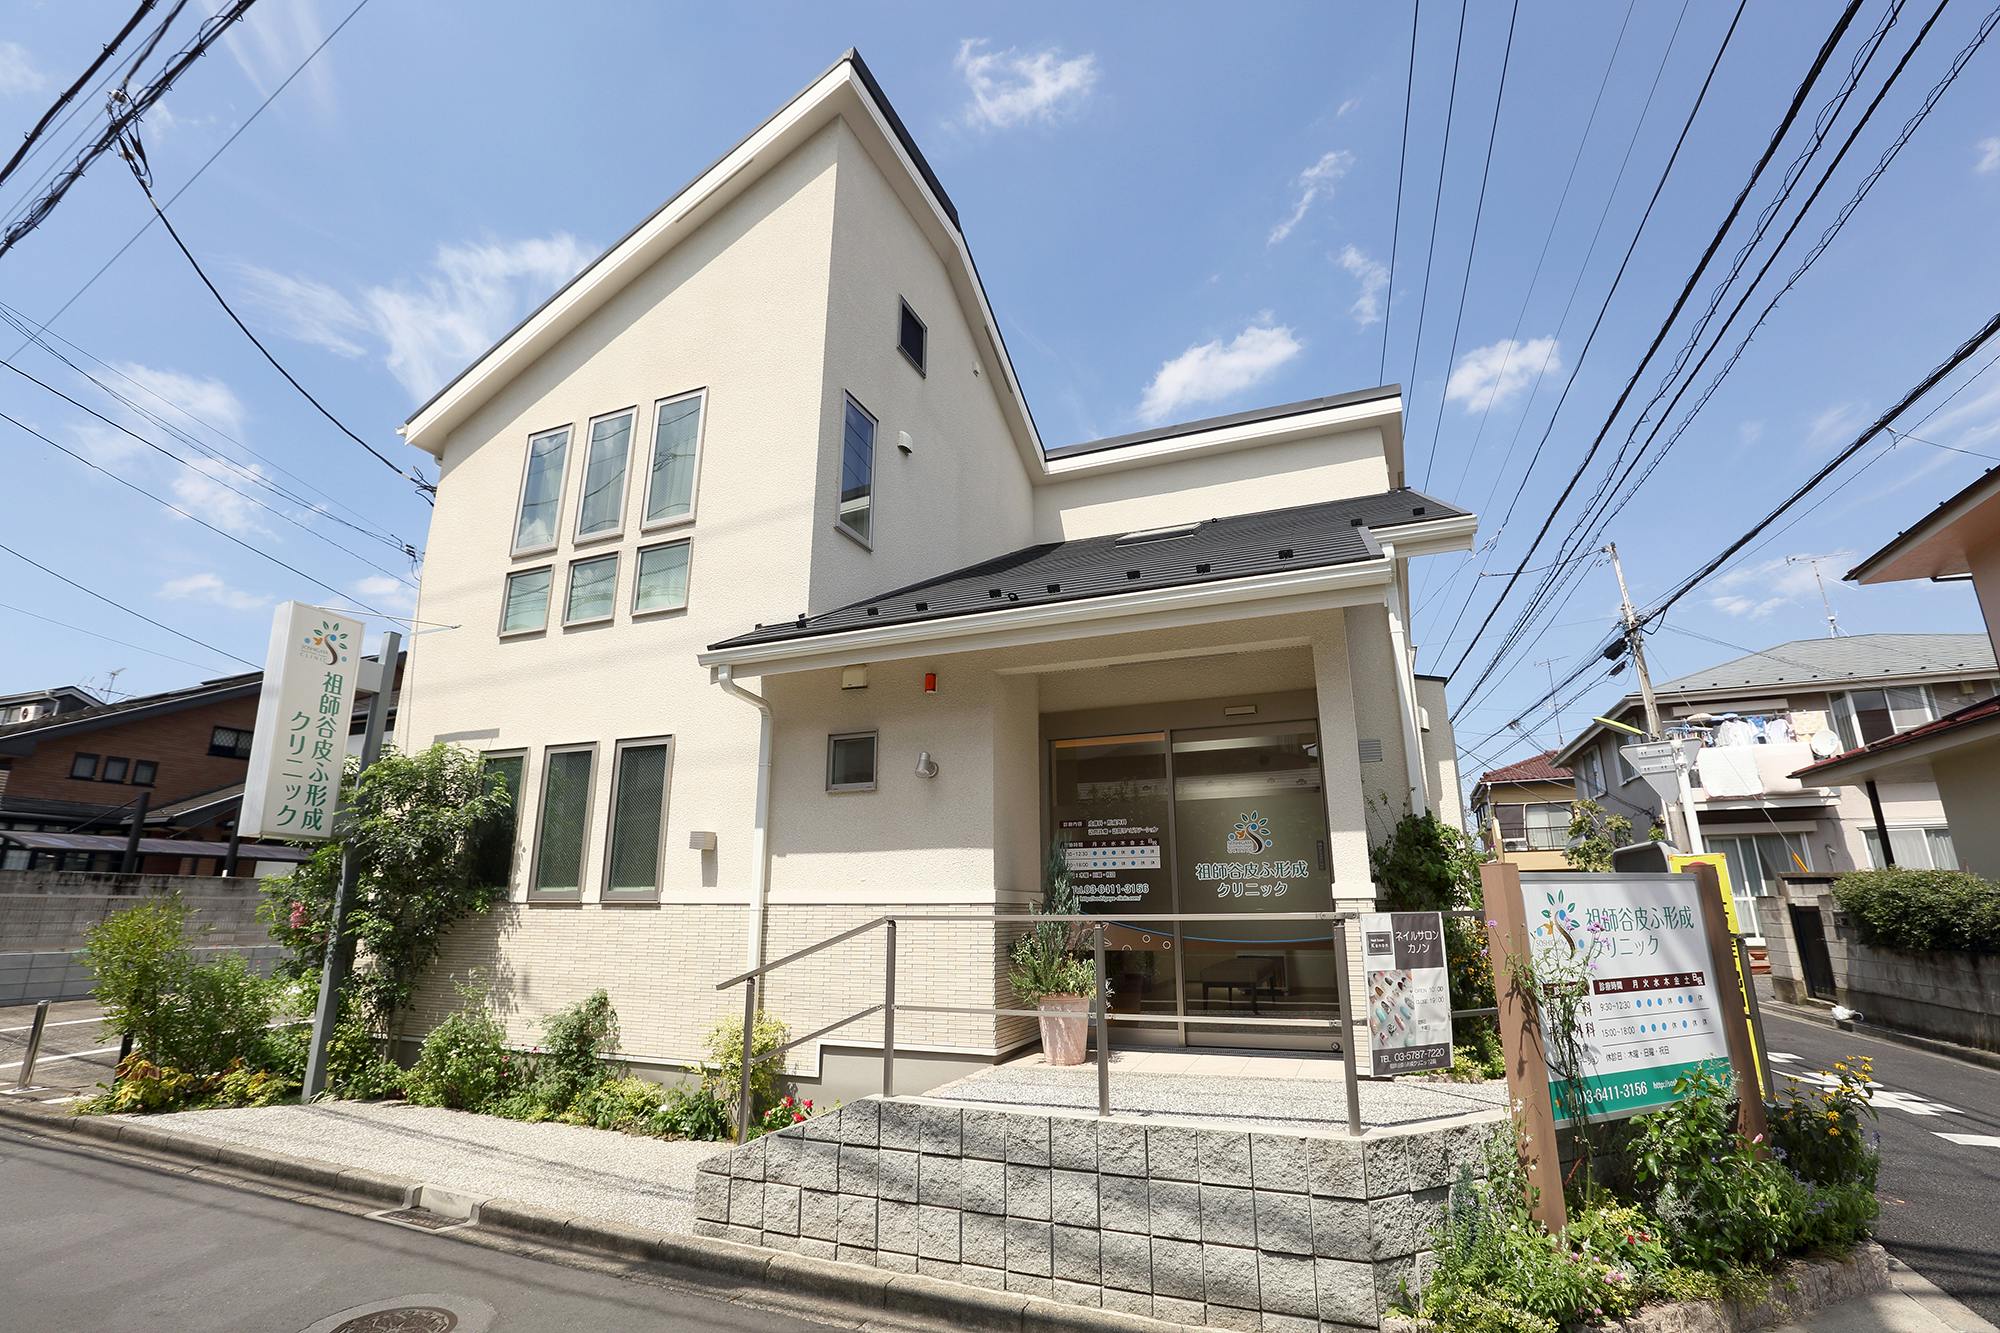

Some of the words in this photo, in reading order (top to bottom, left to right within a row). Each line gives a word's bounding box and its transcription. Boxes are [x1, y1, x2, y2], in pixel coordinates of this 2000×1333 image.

[300, 672, 343, 832] 祖師谷皮ふ形成
[276, 711, 311, 827] クリニック
[1195, 859, 1309, 881] 祖師谷皮ふ形成
[1217, 881, 1289, 898] クリニック
[1585, 905, 1694, 932] 祖師谷皮ふ形成
[1395, 930, 1439, 941] ネイルサロン
[1407, 943, 1430, 954] カノン
[1593, 935, 1659, 958] クリニック
[1632, 979, 1639, 989] 月
[1642, 979, 1650, 988] 火
[1653, 978, 1660, 987] 水
[1663, 977, 1670, 986] 木
[1674, 976, 1681, 986] 金
[1684, 976, 1691, 985] 土
[1394, 1047, 1445, 1062] 03-5787-7220
